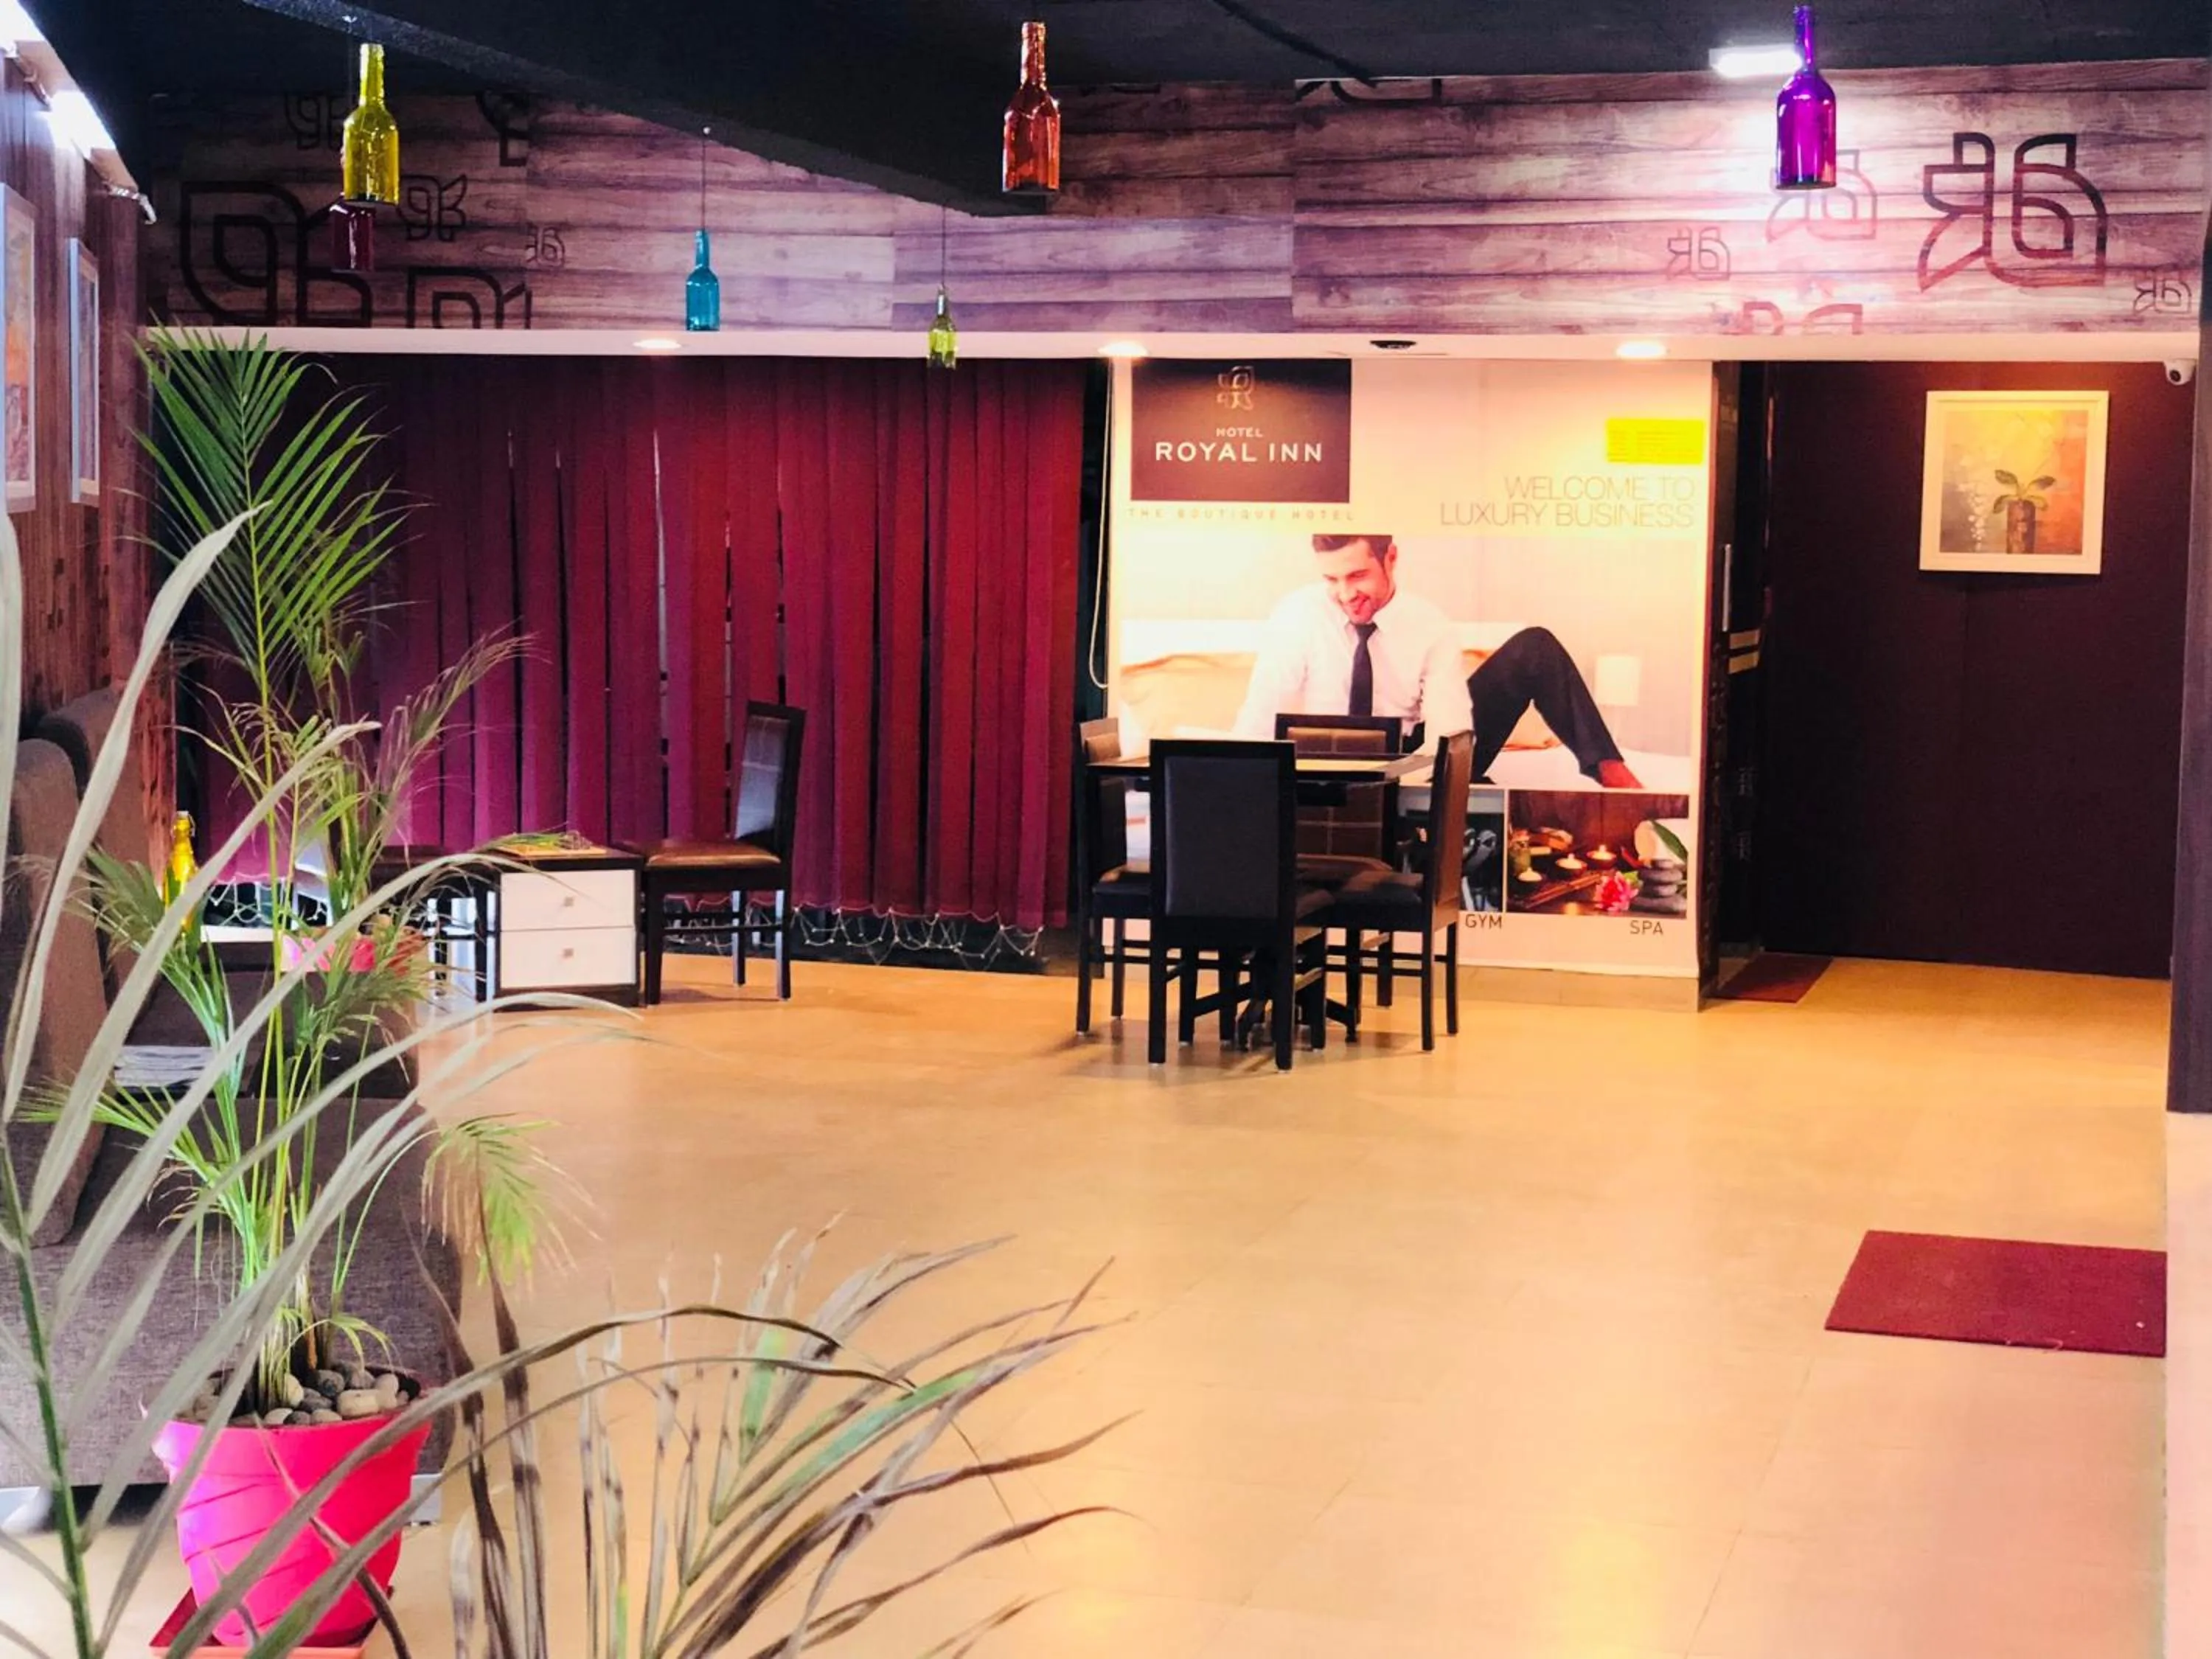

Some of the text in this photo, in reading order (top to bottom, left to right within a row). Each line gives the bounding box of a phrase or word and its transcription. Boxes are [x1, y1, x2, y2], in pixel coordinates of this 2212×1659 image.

[1216, 427, 1263, 438] HOTEL
[1155, 442, 1323, 462] ROYAL INN
[1504, 476, 1695, 501] WELCOME TO
[1127, 507, 1354, 521] THE BOUTIQUE HOTEL
[1440, 502, 1694, 528] LUXURY BUSINESS
[1464, 914, 1503, 929] GYM
[1629, 919, 1664, 936] SPA
